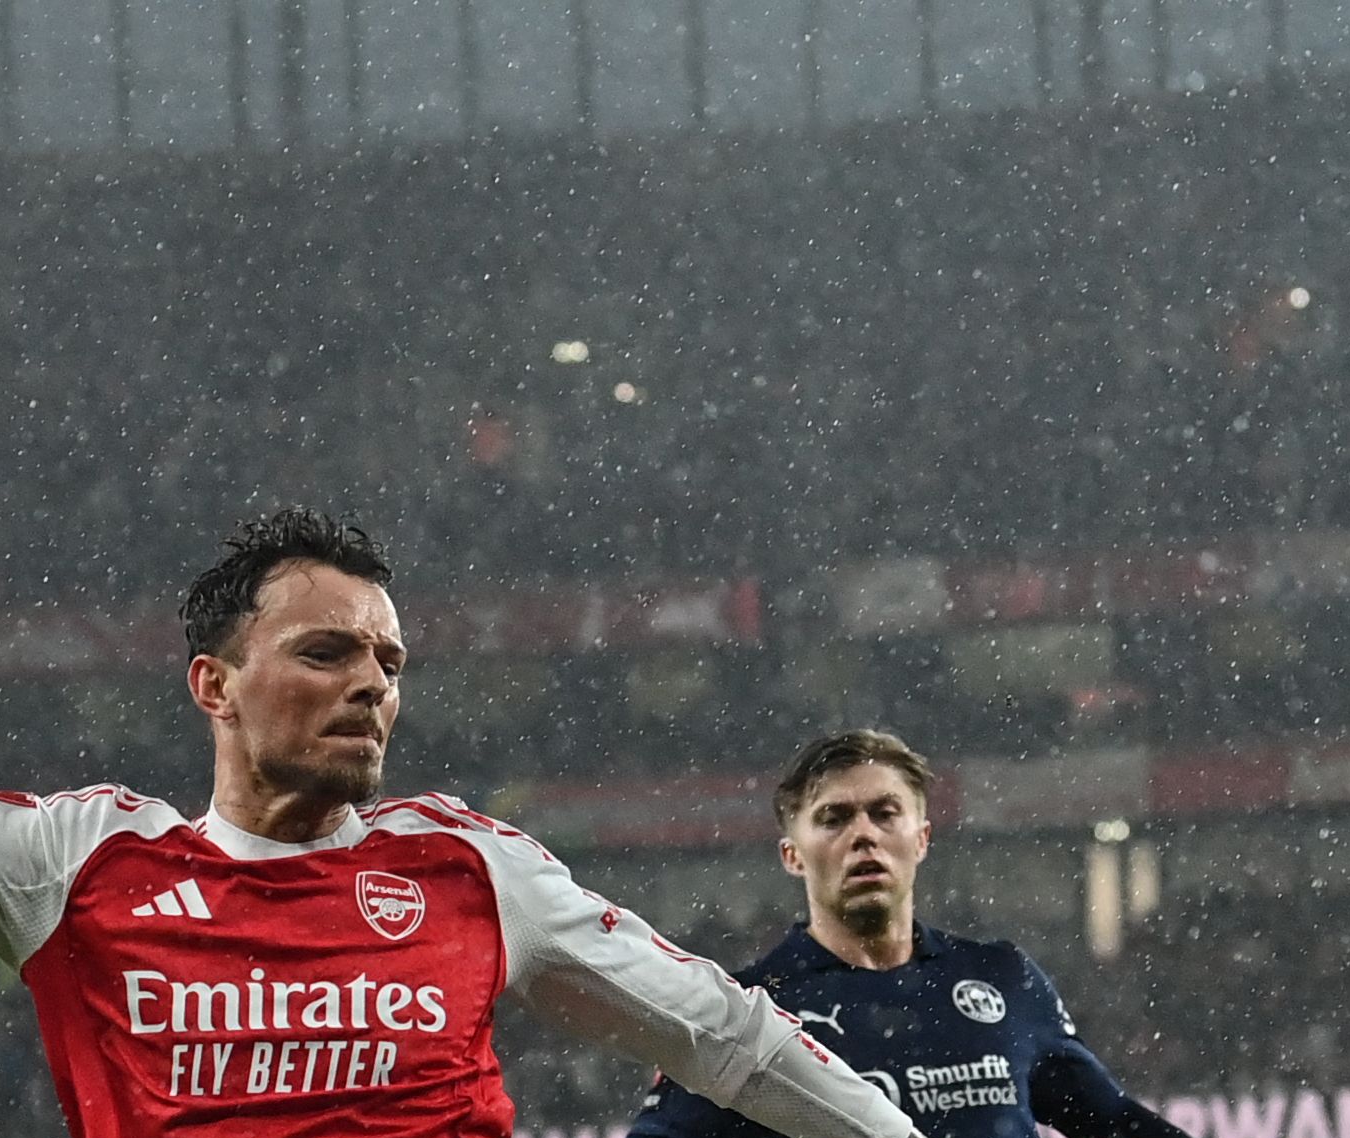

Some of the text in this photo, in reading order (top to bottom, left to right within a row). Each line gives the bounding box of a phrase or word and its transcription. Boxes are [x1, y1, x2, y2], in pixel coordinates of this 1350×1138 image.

[366, 882, 414, 897] Arsenal
[122, 968, 447, 1034] Emirates
[169, 1040, 399, 1097] FLY BETTER
[906, 1054, 1012, 1089] Smurfit
[909, 1080, 1018, 1114] Westrock
